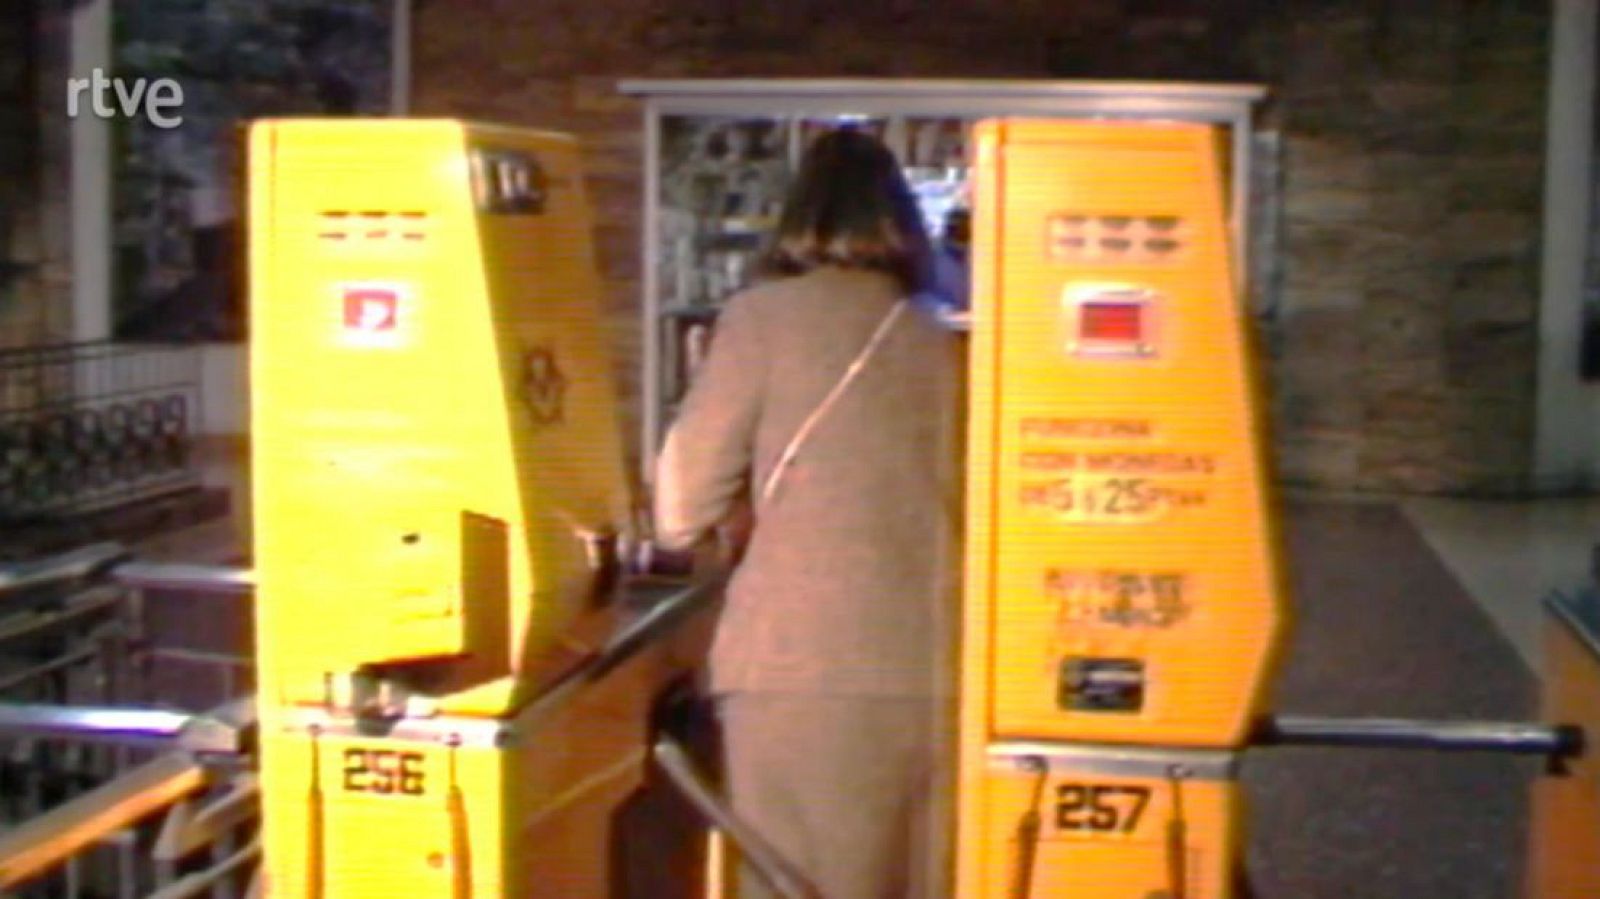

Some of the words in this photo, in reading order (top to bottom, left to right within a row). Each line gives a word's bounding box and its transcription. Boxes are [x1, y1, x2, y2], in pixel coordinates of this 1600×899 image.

[1104, 478, 1148, 515] 25
[342, 746, 426, 796] 256
[1055, 782, 1151, 834] 257
